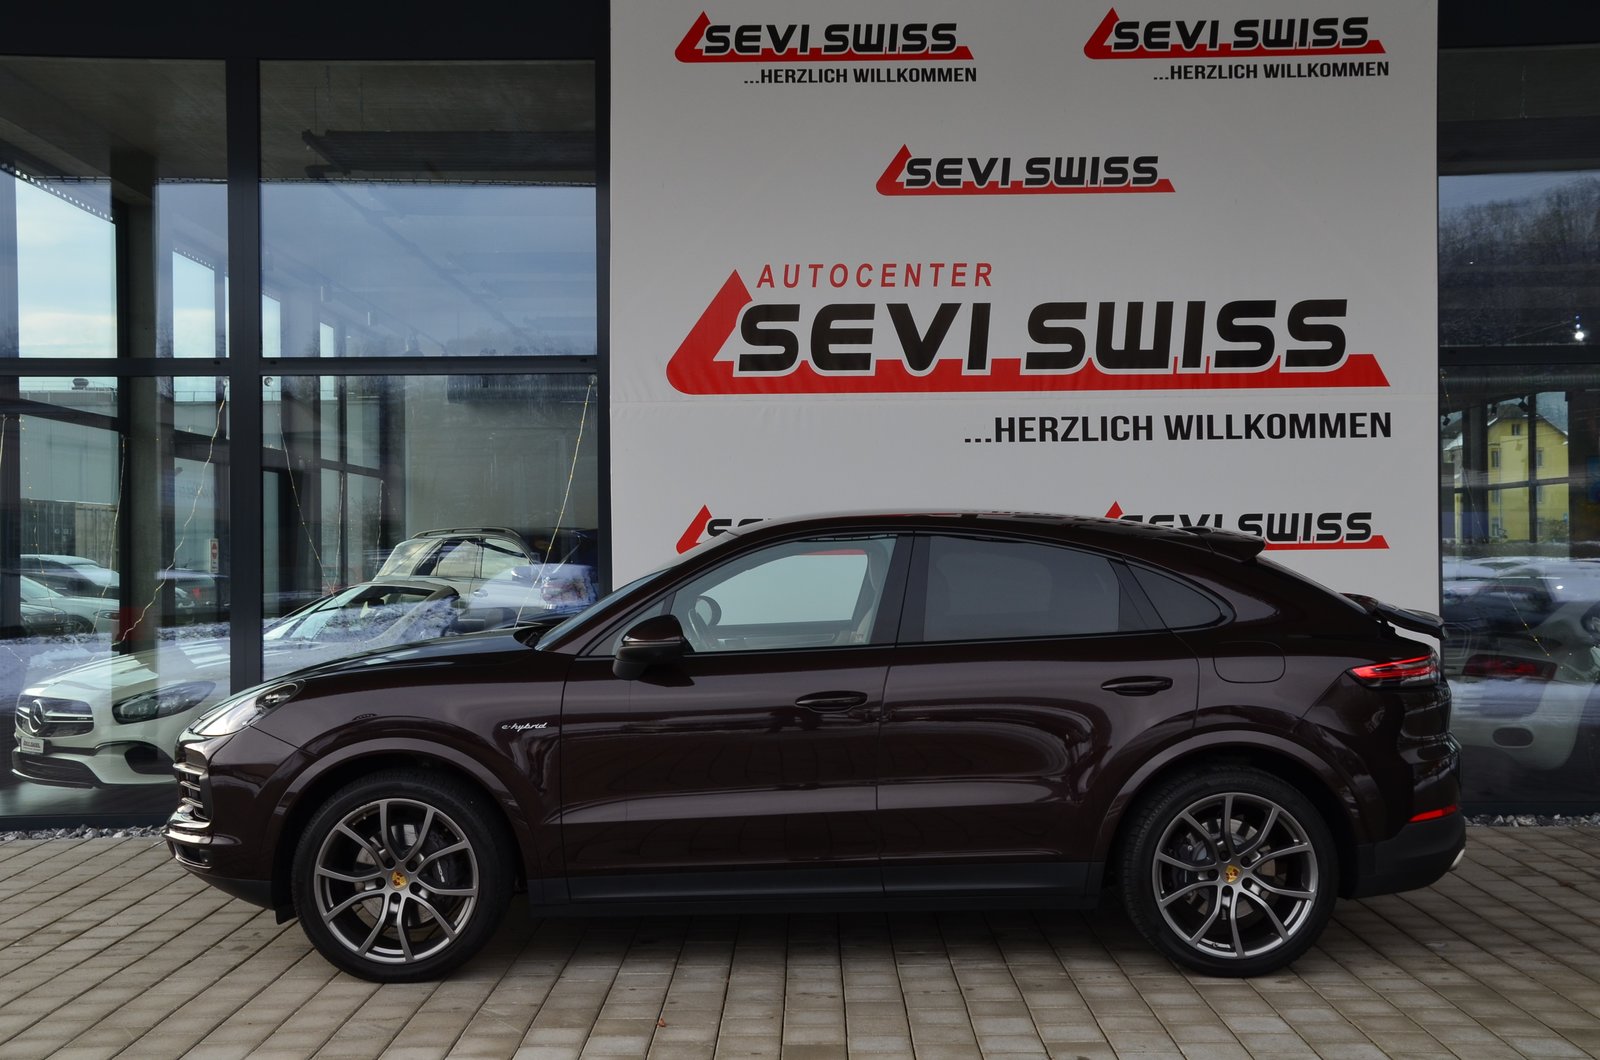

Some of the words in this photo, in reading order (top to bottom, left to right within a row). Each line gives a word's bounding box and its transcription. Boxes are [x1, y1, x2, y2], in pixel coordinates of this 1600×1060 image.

[703, 24, 810, 54] SEVI
[822, 23, 958, 53] SWISS
[1113, 20, 1221, 51] SEVI
[1232, 17, 1370, 48] SWISS
[744, 68, 848, 84] ...HERZLICH
[853, 67, 977, 83] WILLKOMMEN
[1153, 64, 1258, 80] ...HERZLICH
[1263, 61, 1389, 78] WILLKOMMEN
[905, 157, 1011, 187] SEVI
[1024, 156, 1159, 186] SWISS
[756, 262, 993, 289] AUTOCENTER
[738, 302, 991, 372] SEVI
[1025, 299, 1348, 370] SWISS
[964, 415, 1153, 443] ...HERZLICH
[1164, 412, 1391, 441] WILLKOMMEN
[1238, 512, 1372, 541] SWISS
[501, 722, 548, 733] e-hybrid
